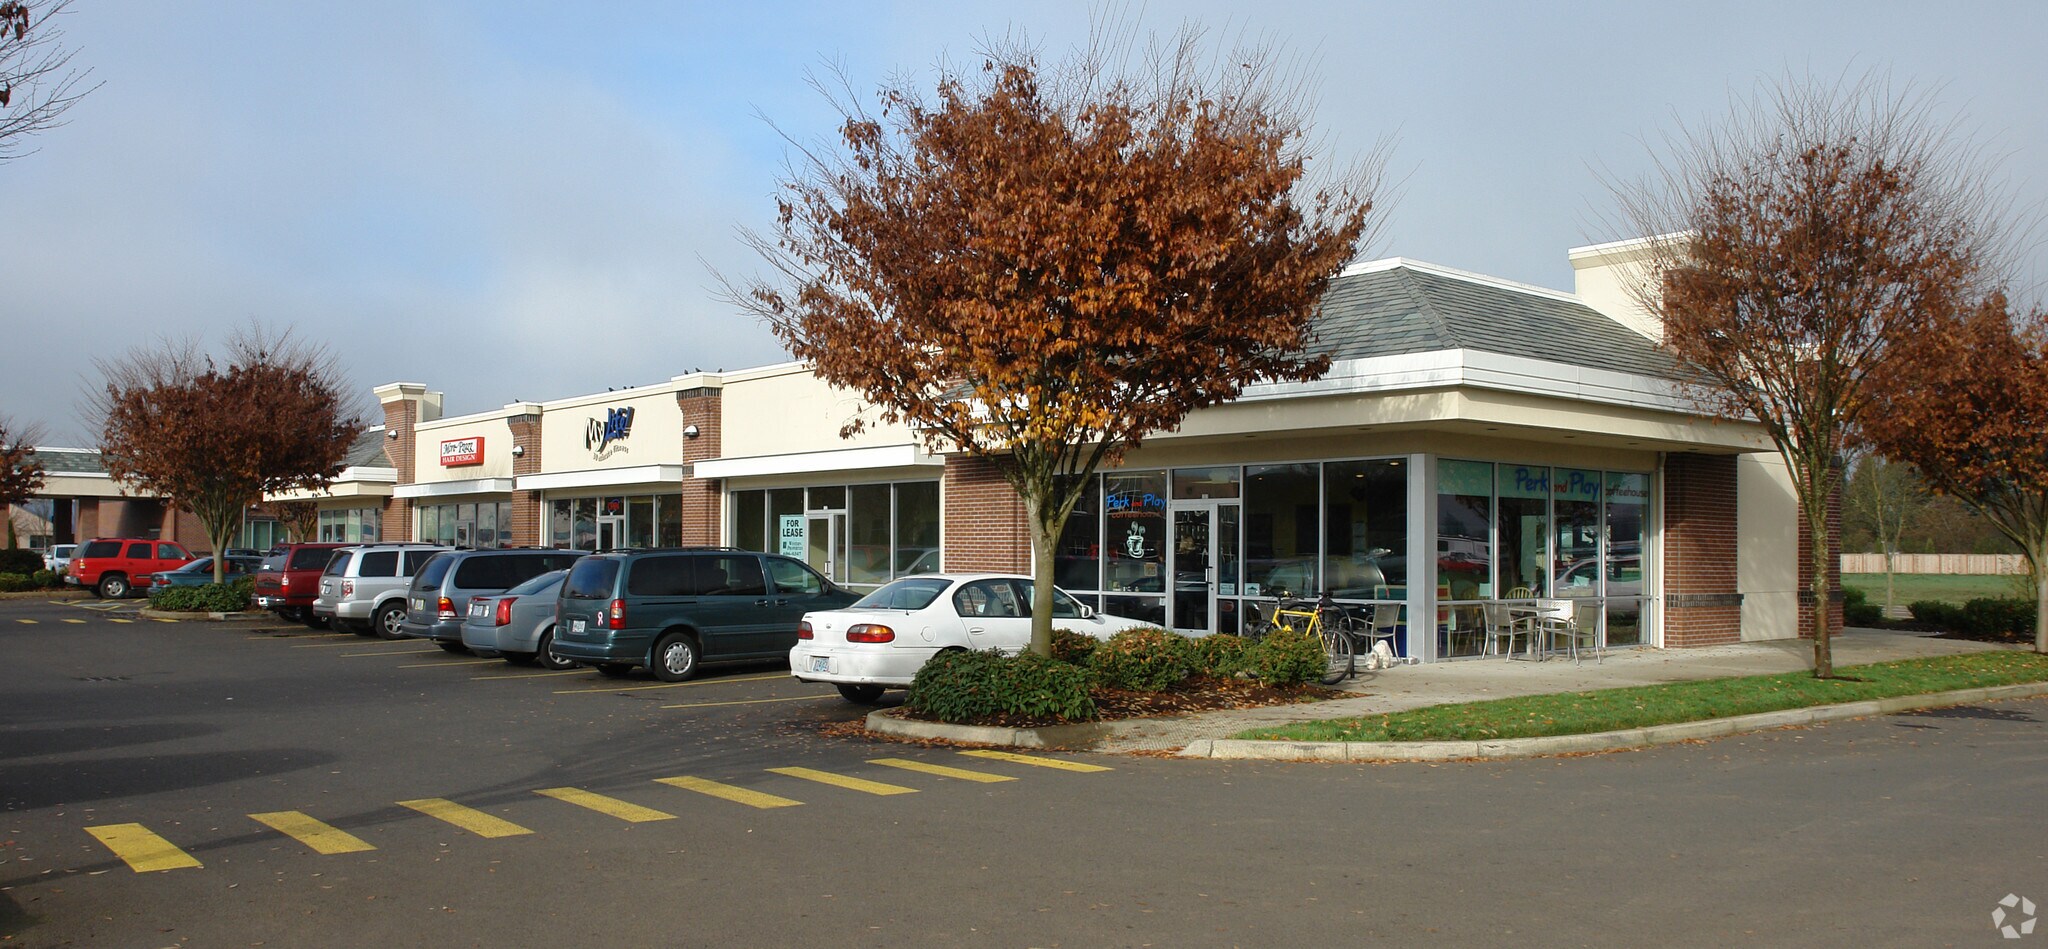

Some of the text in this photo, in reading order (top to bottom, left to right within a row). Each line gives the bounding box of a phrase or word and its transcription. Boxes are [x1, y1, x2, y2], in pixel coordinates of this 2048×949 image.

[584, 406, 635, 453] My Life!
[455, 454, 475, 462] DESIGN
[1515, 468, 1548, 492] Perk
[1554, 480, 1567, 493] and
[1569, 470, 1599, 500] Play
[1106, 495, 1129, 509] Perk
[1143, 493, 1167, 510] Play
[786, 519, 799, 527] FOR
[782, 528, 803, 537] LEASE
